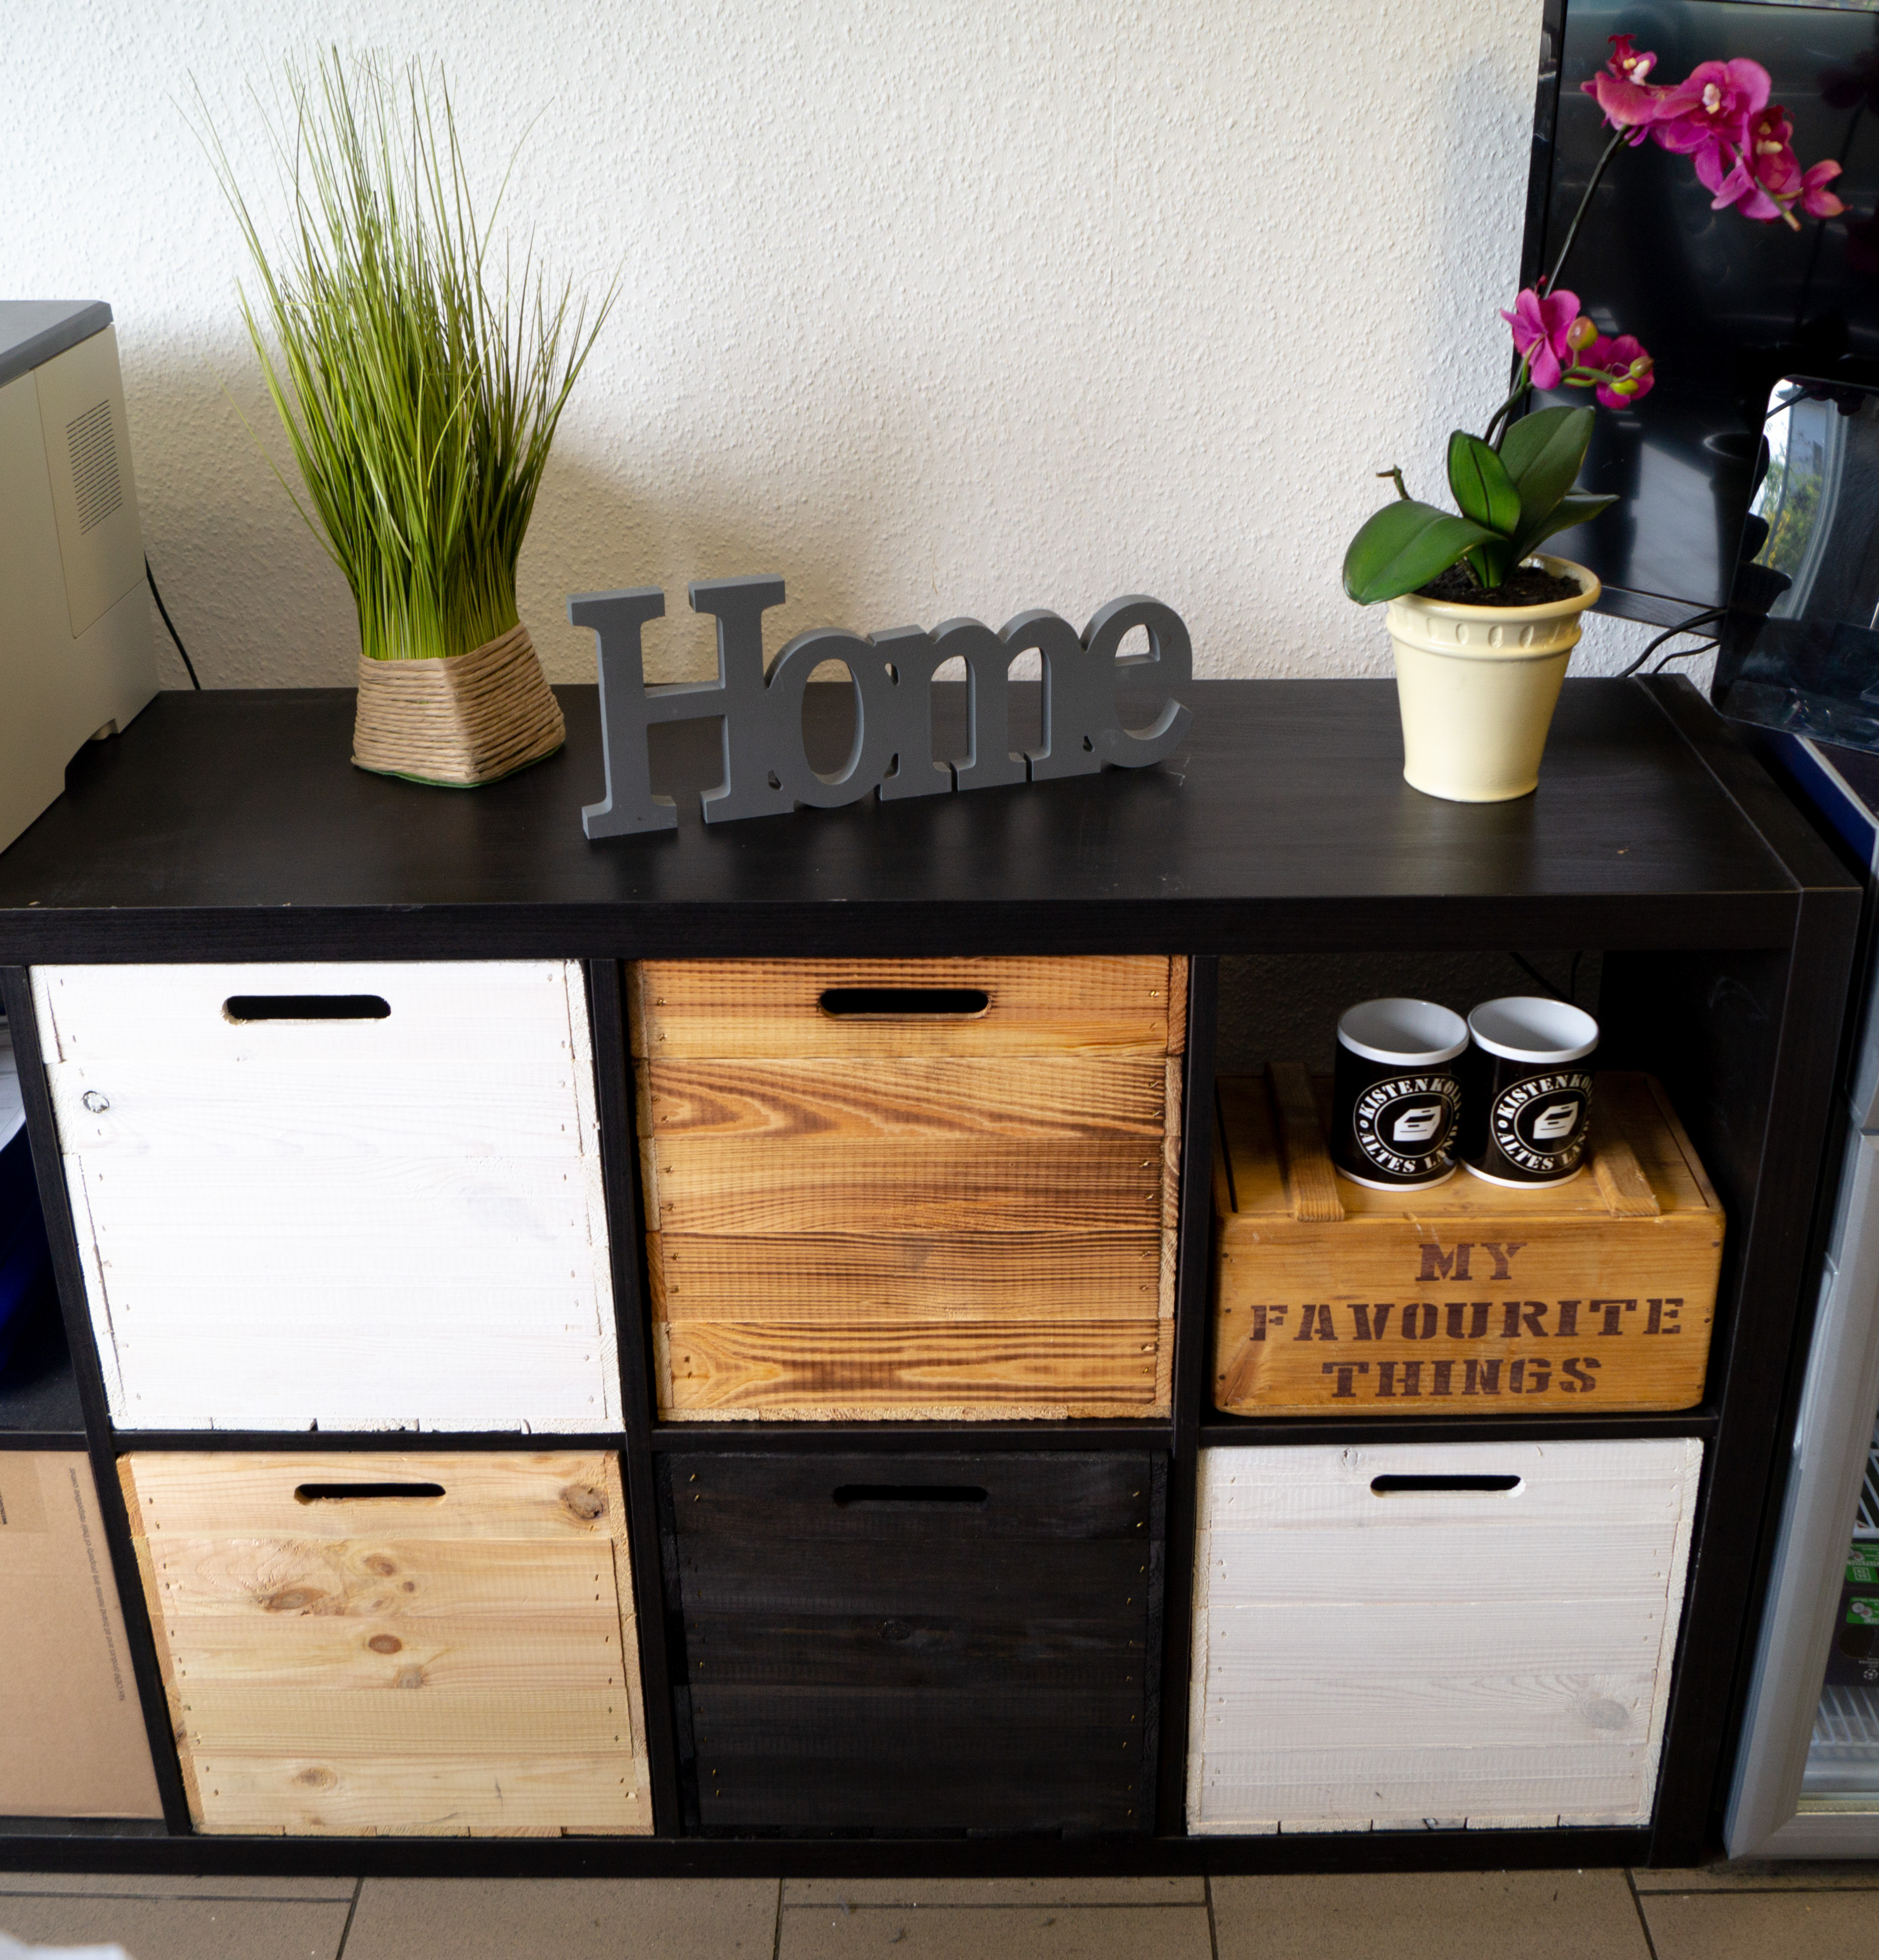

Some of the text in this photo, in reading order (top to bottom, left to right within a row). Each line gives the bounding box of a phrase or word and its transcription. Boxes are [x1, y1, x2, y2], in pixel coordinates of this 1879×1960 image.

[566, 574, 1194, 839] Home
[1359, 1132, 1417, 1172] ALTES
[1497, 1133, 1555, 1170] ALTES
[1415, 1242, 1527, 1282] MY
[1249, 1297, 1685, 1342] FAVOURITE
[1322, 1358, 1602, 1398] THINGS
[114, 1673, 123, 1689] OEM
